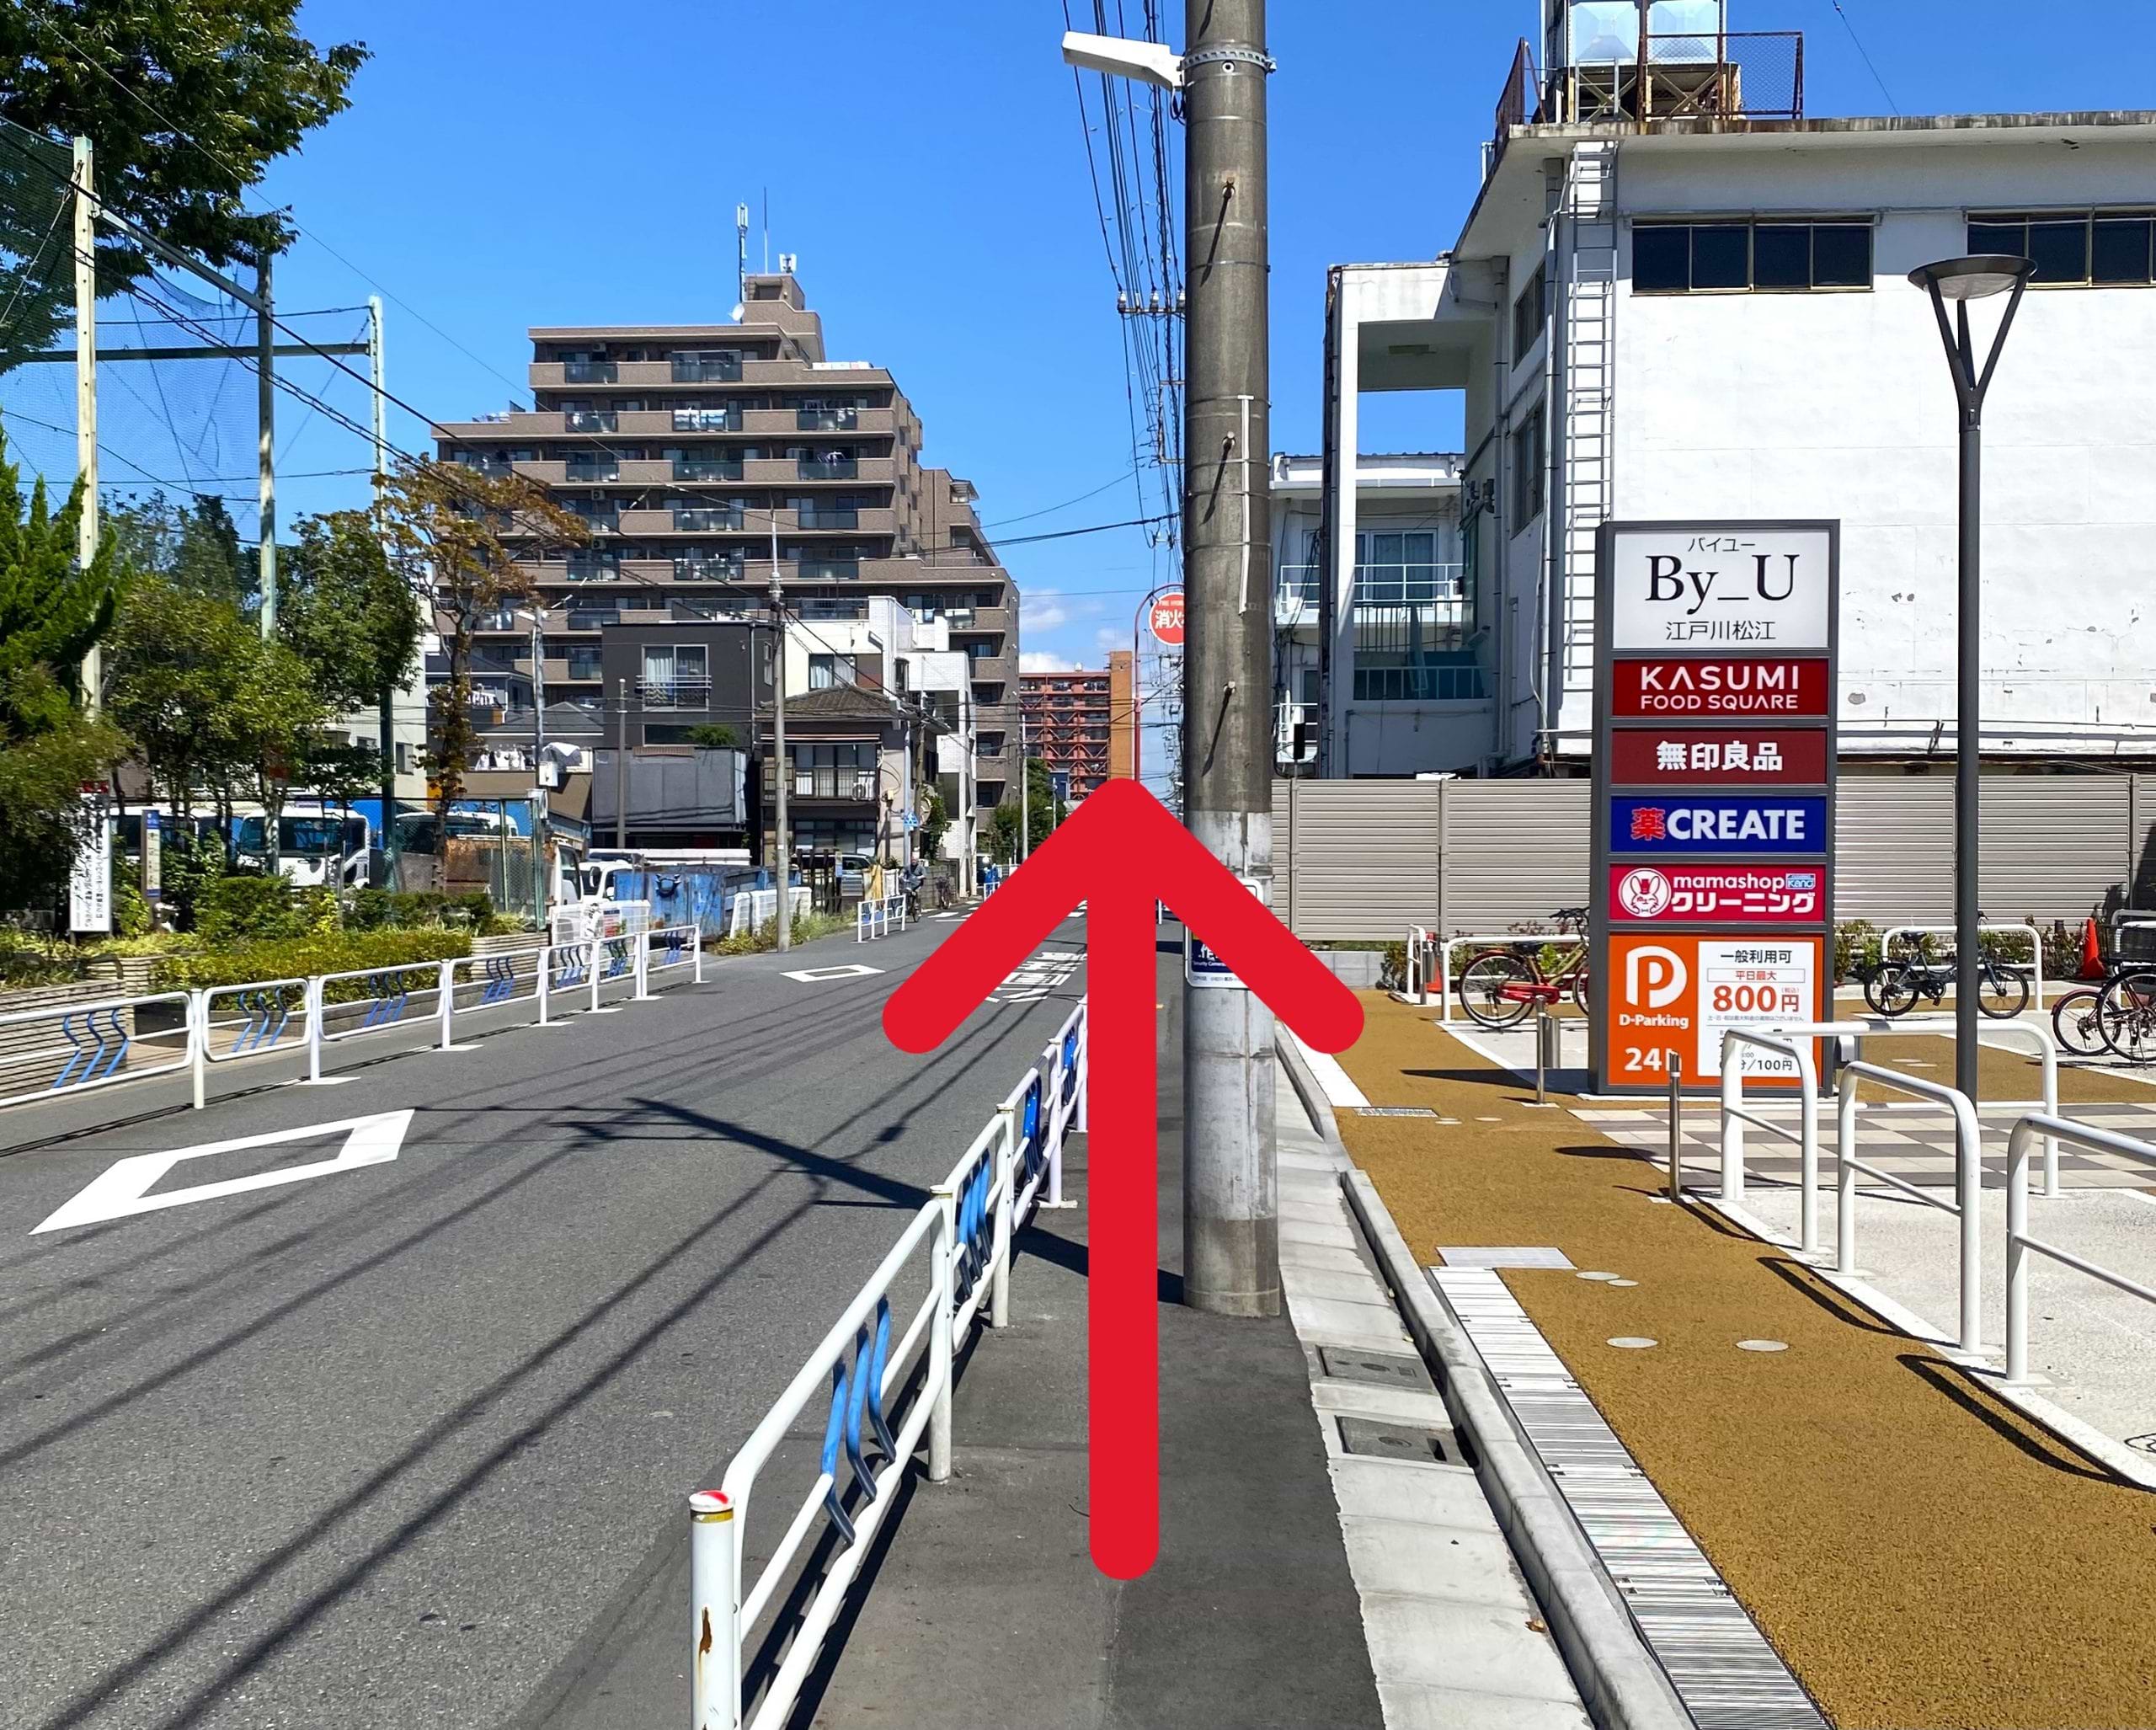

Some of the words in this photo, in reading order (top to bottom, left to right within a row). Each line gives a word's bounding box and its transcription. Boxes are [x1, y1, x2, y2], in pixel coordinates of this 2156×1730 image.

[1688, 537, 1756, 553] バイユー
[1645, 553, 1801, 616] By_U
[1665, 620, 1777, 641] 江戸川松江
[1641, 665, 1799, 691] KASUMI
[1641, 694, 1701, 710] FOOD
[1707, 694, 1799, 711] SQUARE
[1656, 740, 1784, 772] 無印良品
[1667, 809, 1806, 840] CREATE
[1673, 873, 1785, 892] mamashop
[1670, 891, 1816, 914] クリーニング
[1720, 949, 1793, 964] 一般利用可
[1735, 970, 1777, 980] 平日最大
[1619, 1013, 1689, 1030] D-Parking
